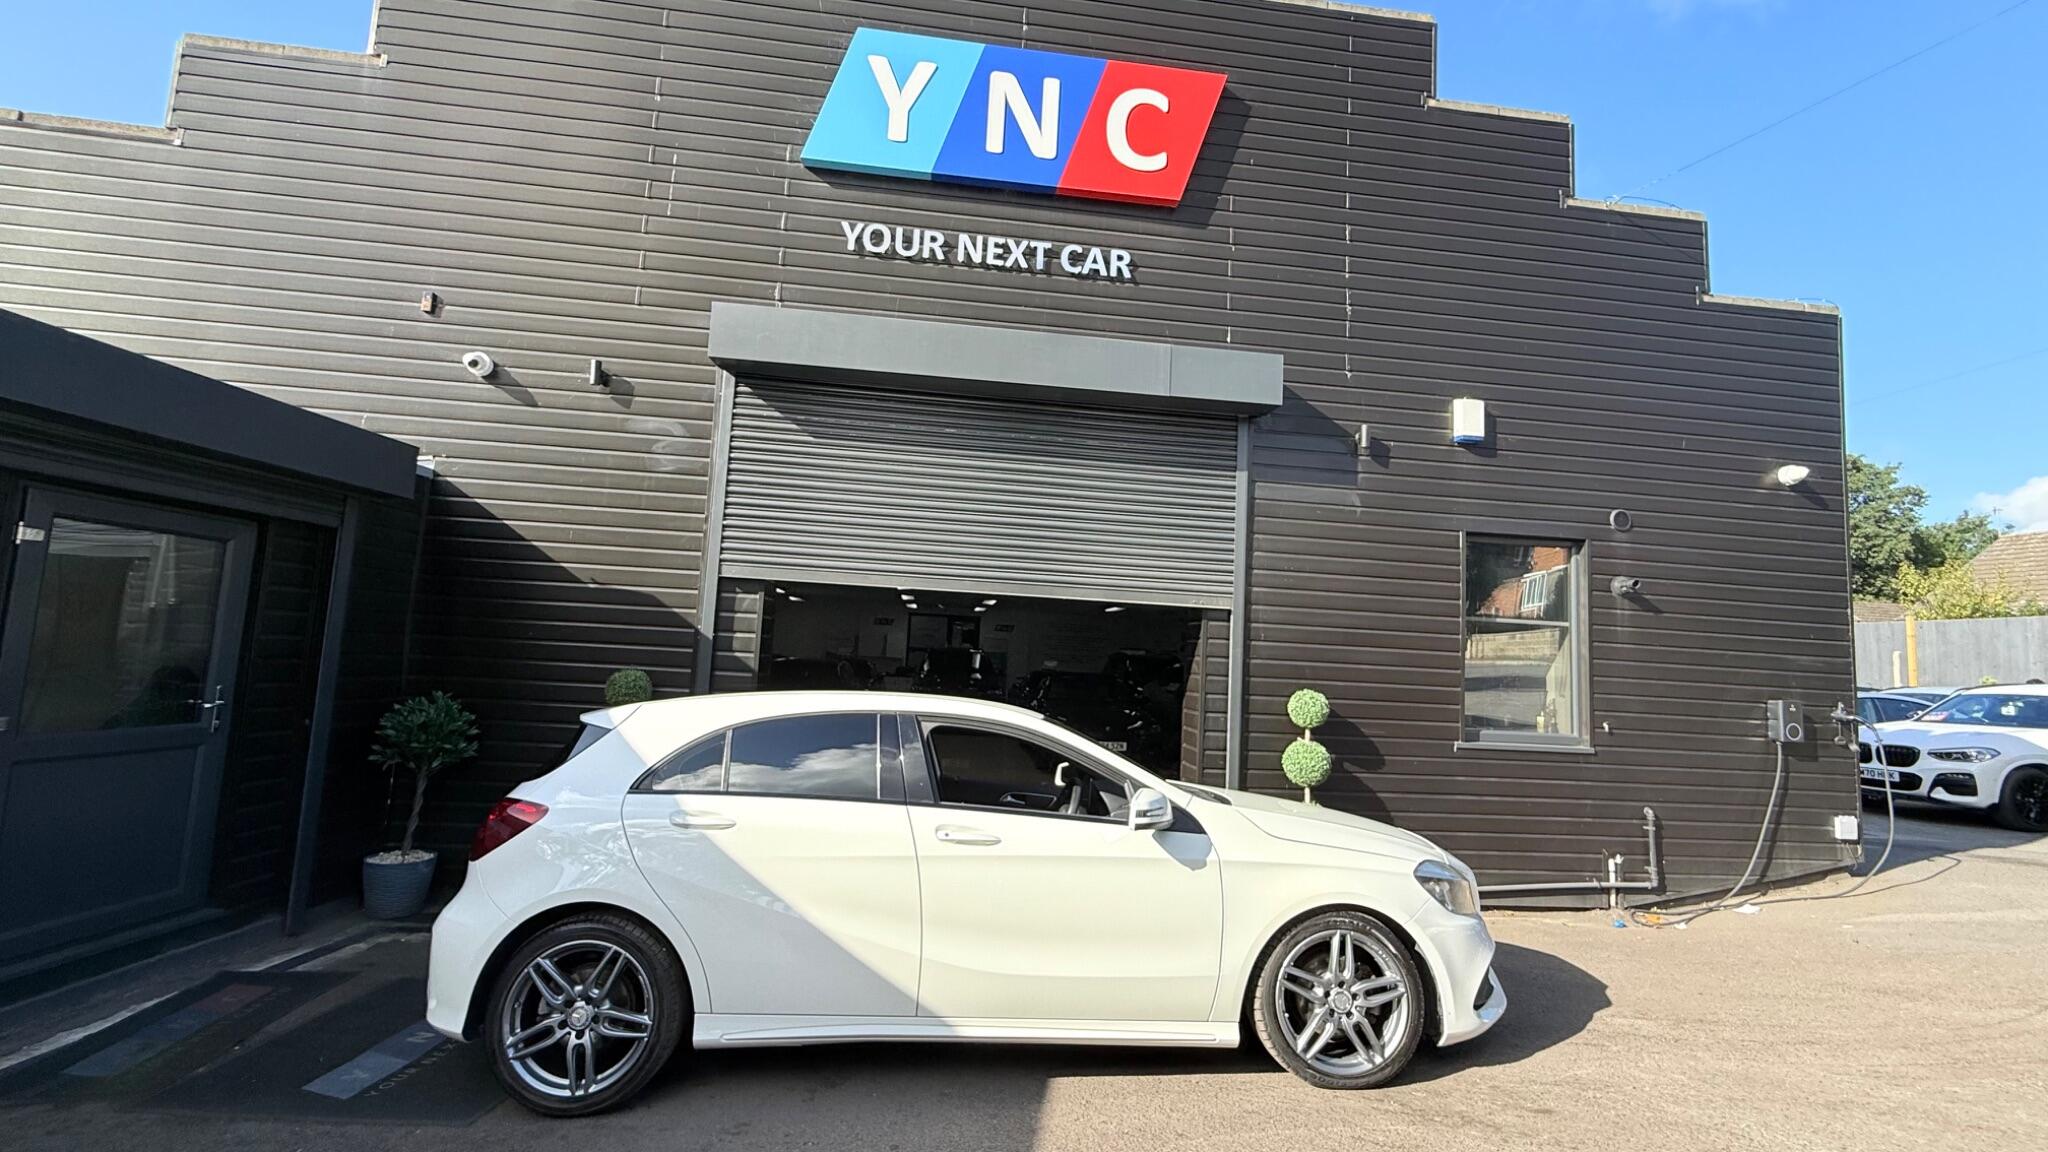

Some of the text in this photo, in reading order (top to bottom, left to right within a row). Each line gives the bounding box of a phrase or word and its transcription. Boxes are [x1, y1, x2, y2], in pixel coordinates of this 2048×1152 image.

[867, 54, 1170, 172] YNC
[841, 220, 1132, 279] YOUR NEXT CAR
